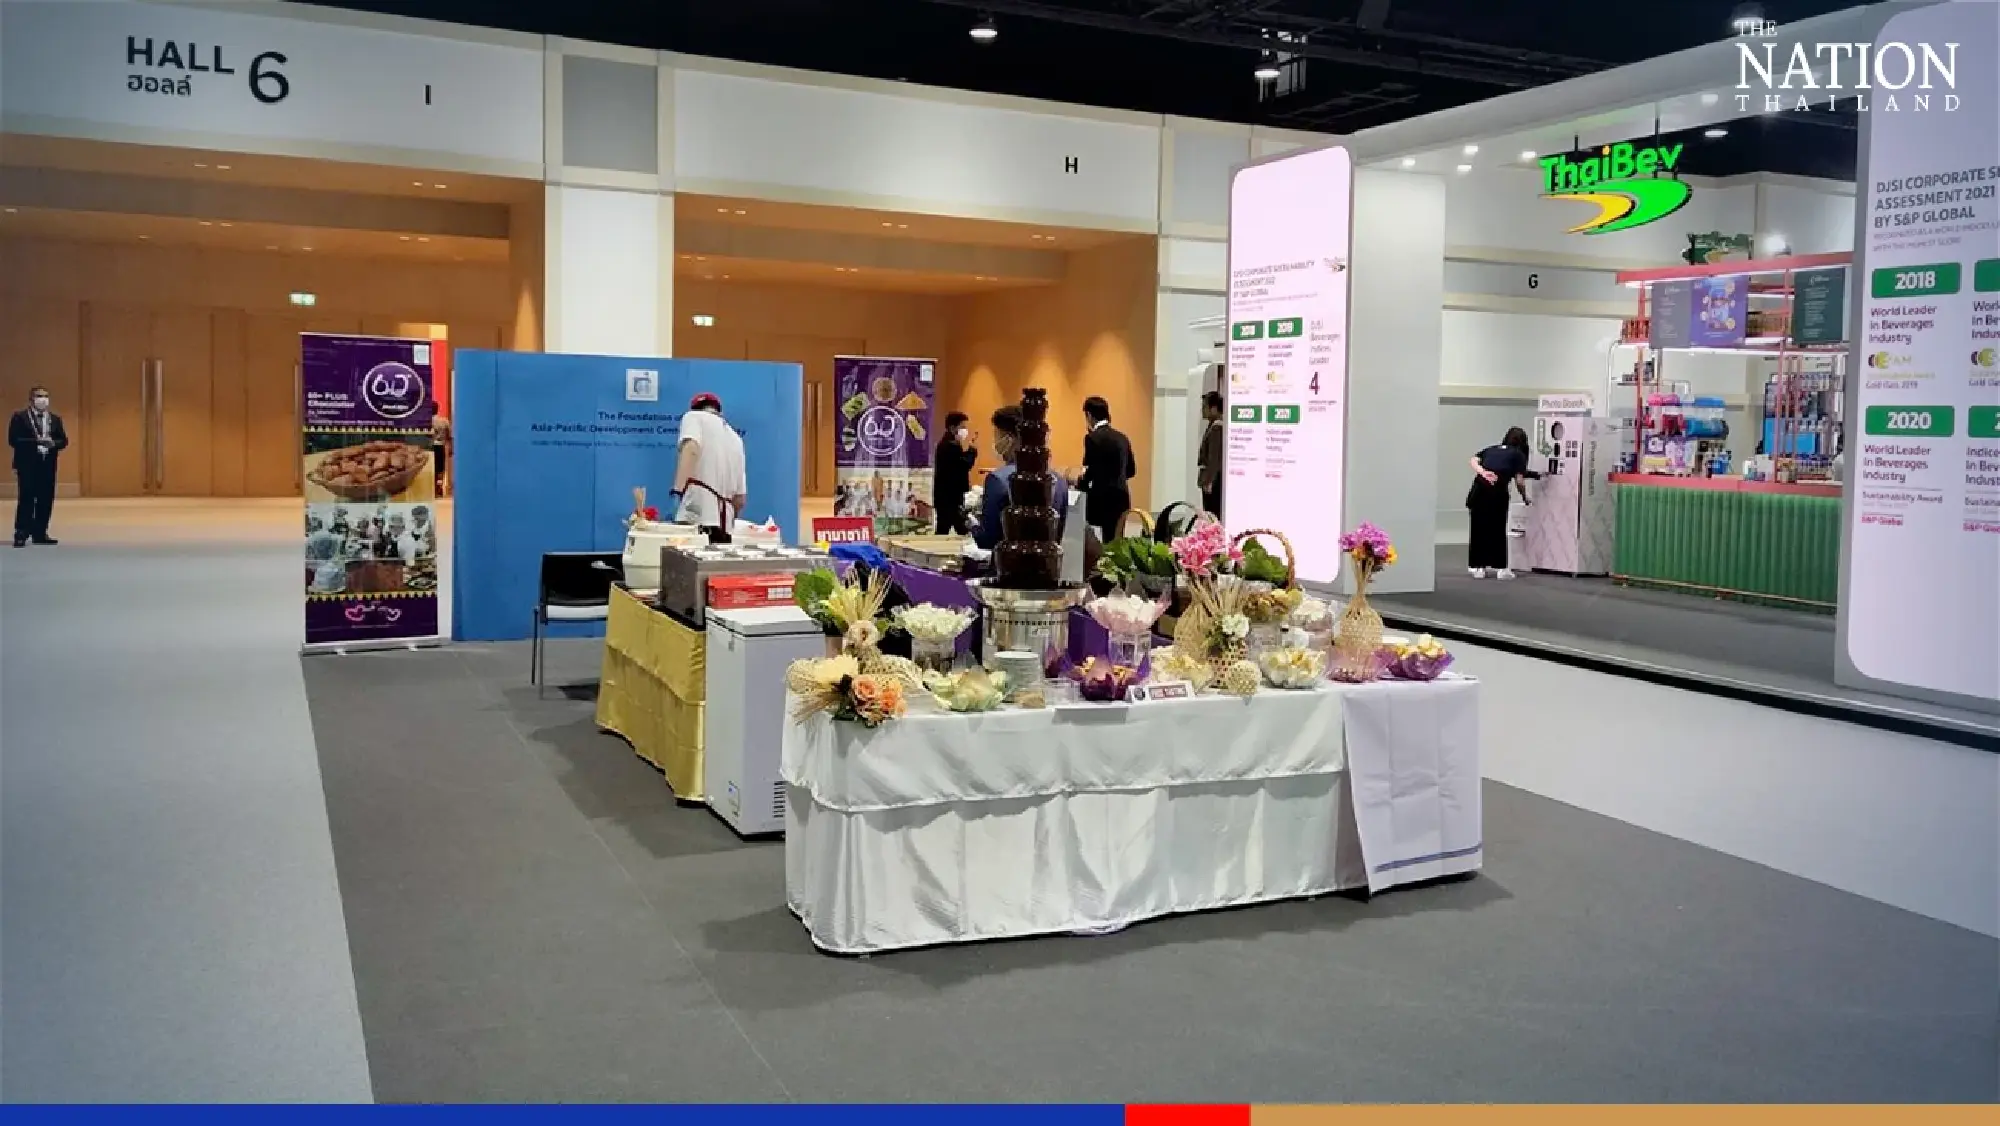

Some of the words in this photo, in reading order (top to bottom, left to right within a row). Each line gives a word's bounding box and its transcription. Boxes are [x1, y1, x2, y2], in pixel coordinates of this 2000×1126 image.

[127, 35, 235, 74] HALL
[248, 51, 290, 104] 6
[127, 74, 192, 97] ฮอลล์
[1065, 156, 1078, 174] H
[1538, 142, 1684, 190] ThaiBev
[1876, 180, 1903, 193] DJSI
[1905, 167, 1986, 190] CORPORATE
[1875, 189, 1963, 210] ASSESSMENT
[1965, 185, 1996, 200] 2021
[1874, 214, 1892, 228] BY
[1894, 212, 1920, 226] S&P
[1922, 206, 1976, 223] GLOBAL
[1528, 274, 1539, 289] G
[1895, 271, 1936, 290] 2018
[1870, 306, 1900, 317] World
[1902, 304, 1938, 316] Leader
[1881, 320, 1935, 331] Beverages
[1868, 333, 1912, 345] Industry
[1308, 371, 1320, 395] 4
[598, 411, 616, 421] The
[618, 411, 673, 421] Foundation
[1887, 411, 1932, 429] 2020
[530, 423, 587, 434] Asia-Pacific
[590, 424, 655, 435] Development
[1864, 444, 1894, 455] World
[1896, 445, 1932, 456] Leader
[1875, 457, 1929, 471] Beverages
[1862, 470, 1906, 483] Industry
